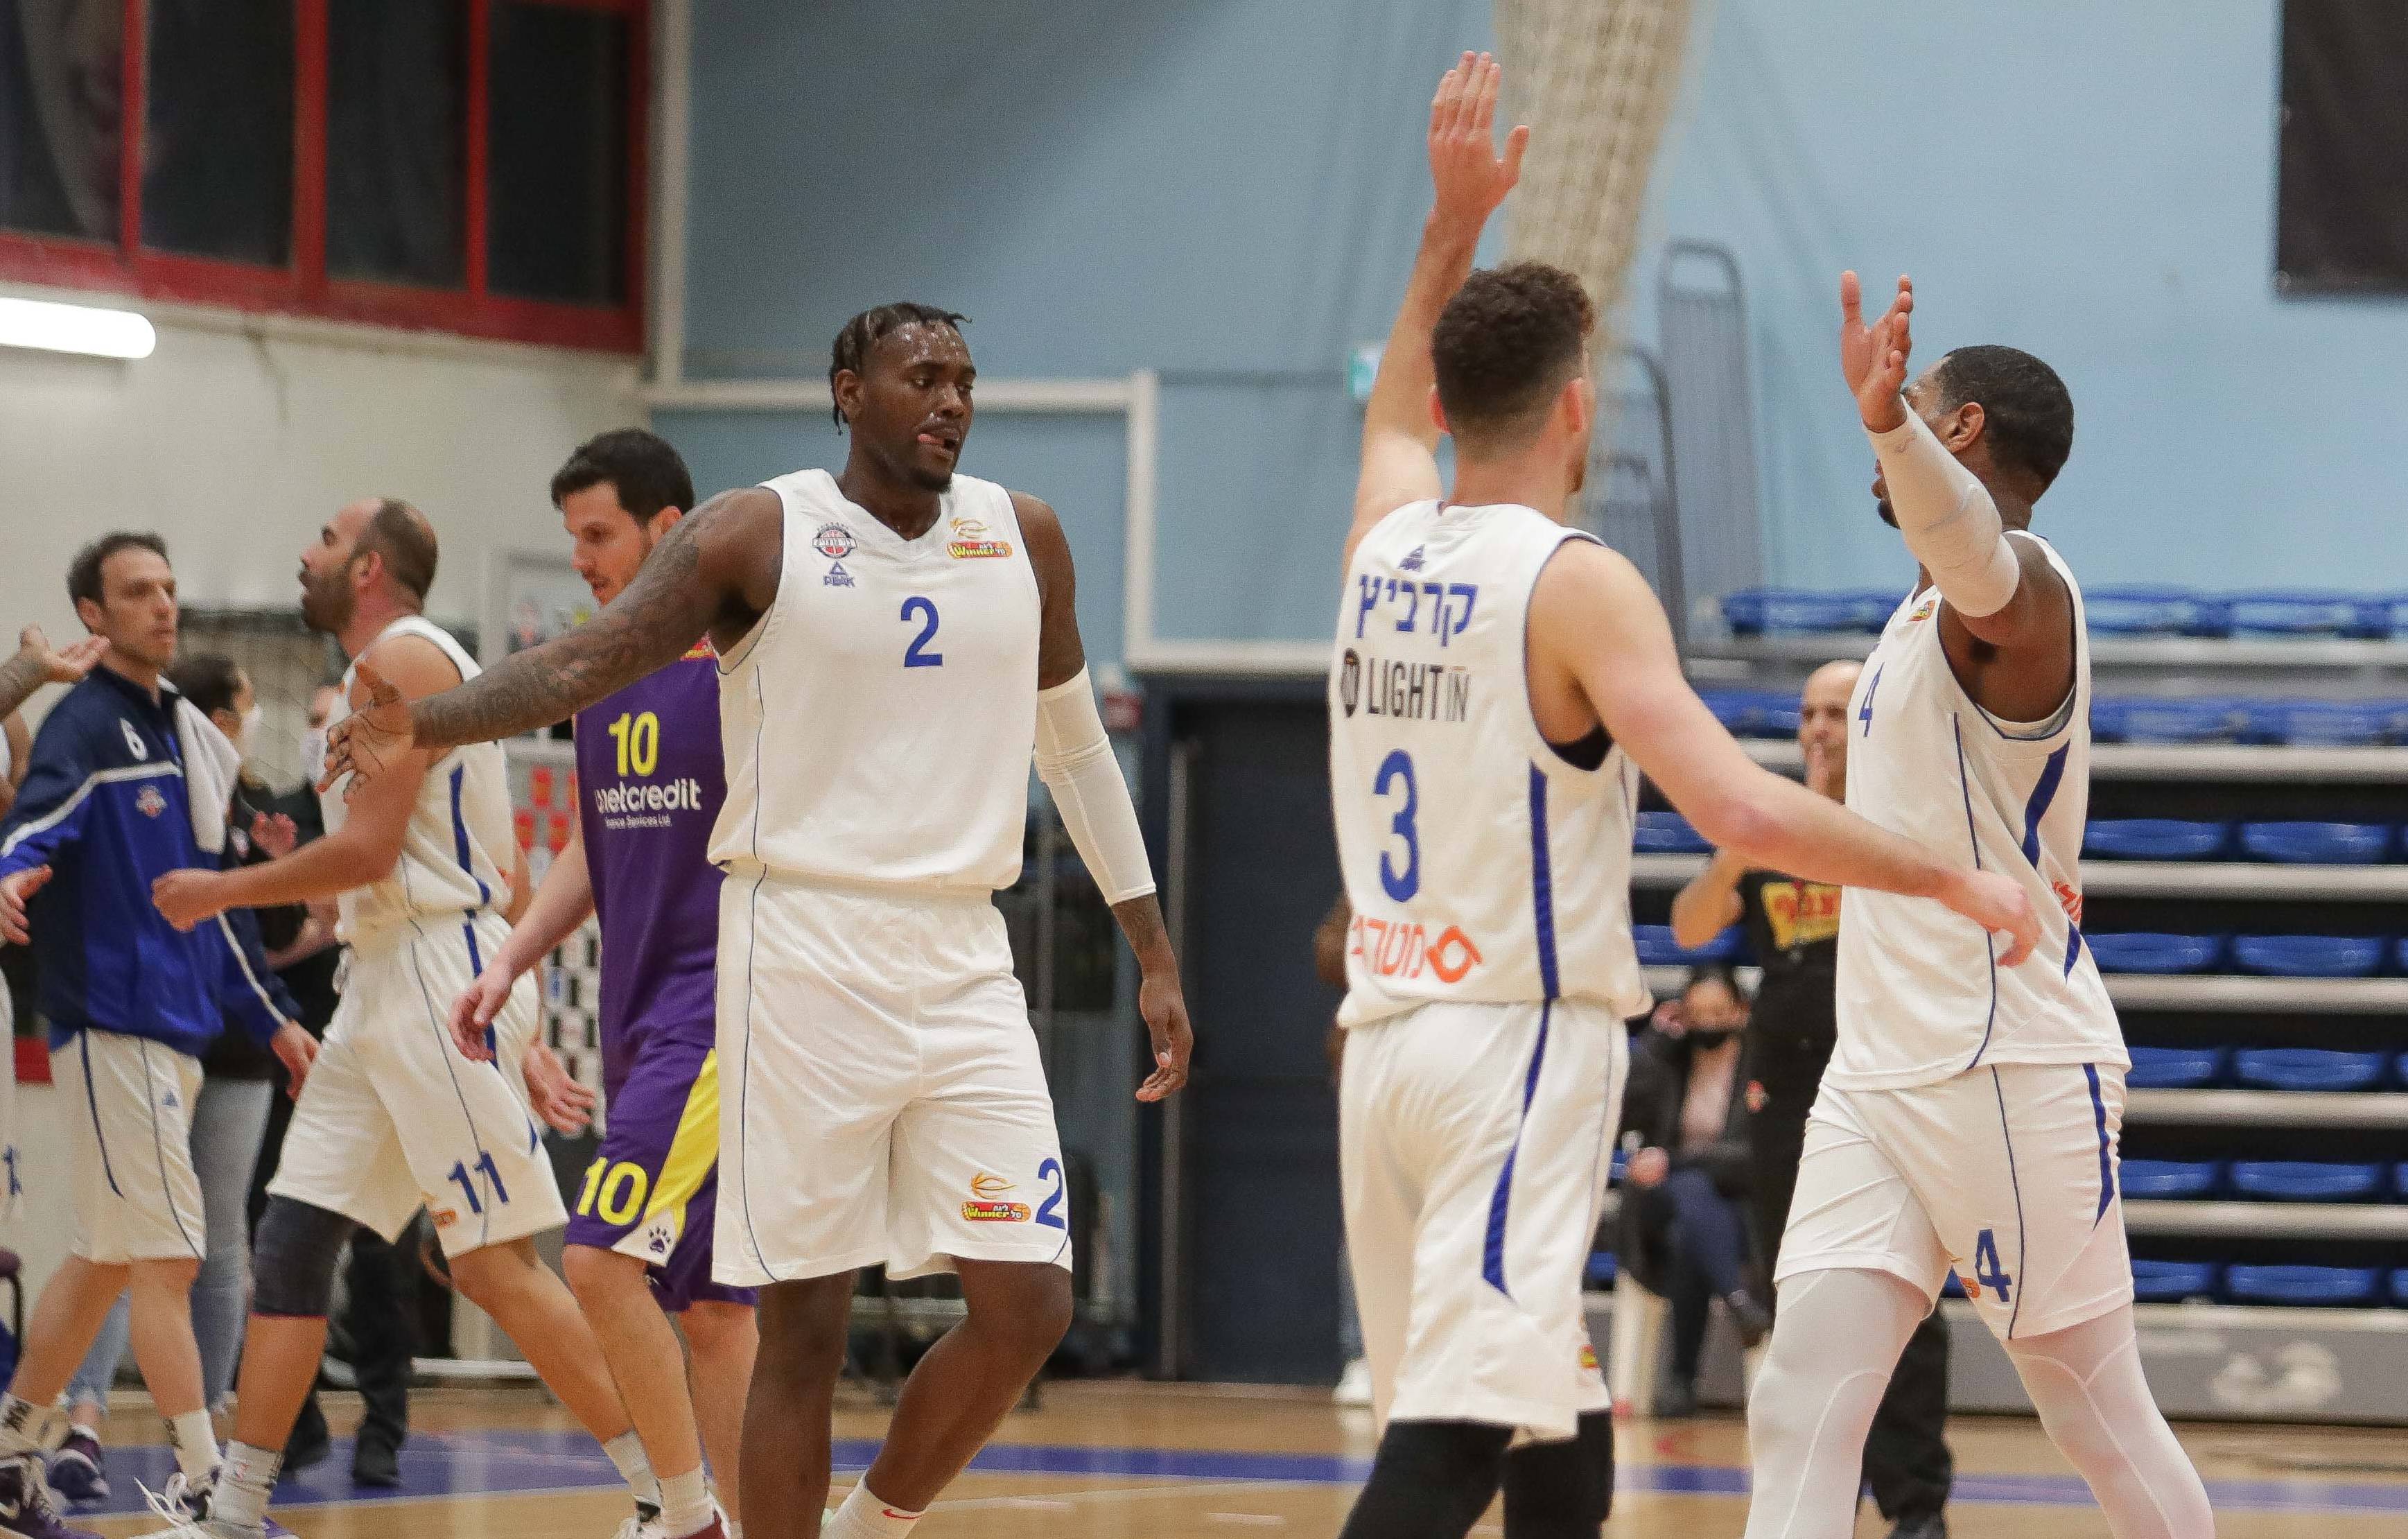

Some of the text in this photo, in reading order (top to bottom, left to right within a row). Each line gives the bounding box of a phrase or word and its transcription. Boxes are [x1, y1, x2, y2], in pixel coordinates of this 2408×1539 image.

[900, 595, 943, 667] 2
[1356, 574, 1478, 648] קרביץ
[1858, 661, 1885, 738] 4
[119, 717, 148, 761] 6
[609, 711, 660, 777] 10
[1373, 748, 1420, 903] 3
[447, 1151, 509, 1214] 11
[577, 1156, 649, 1226] 10
[967, 1206, 1010, 1219] Winner
[1036, 1158, 1066, 1230] 2
[1975, 1228, 2012, 1302] 4
